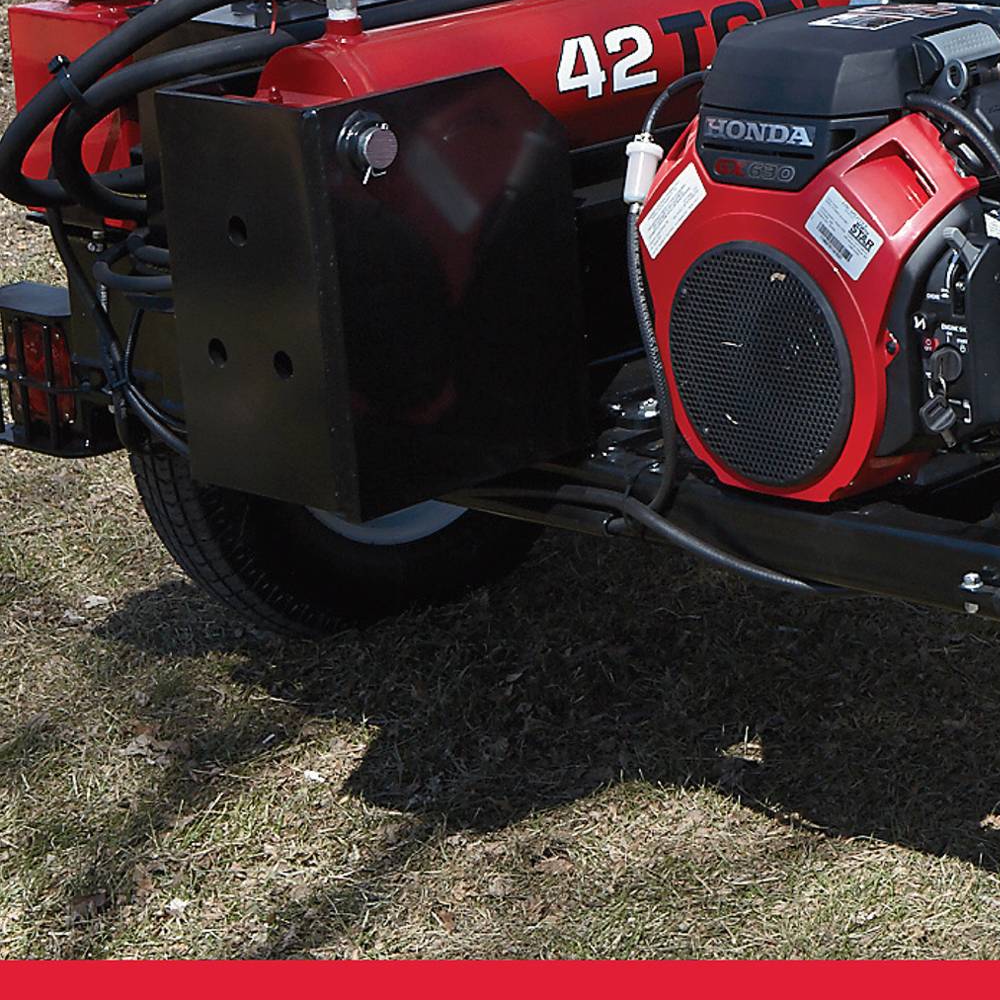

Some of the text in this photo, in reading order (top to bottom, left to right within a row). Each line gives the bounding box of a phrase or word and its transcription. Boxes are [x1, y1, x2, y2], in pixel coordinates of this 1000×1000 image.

[556, 24, 658, 99] 42
[705, 118, 814, 148] HONDA
[714, 158, 796, 182] GX630
[850, 223, 875, 251] STAR
